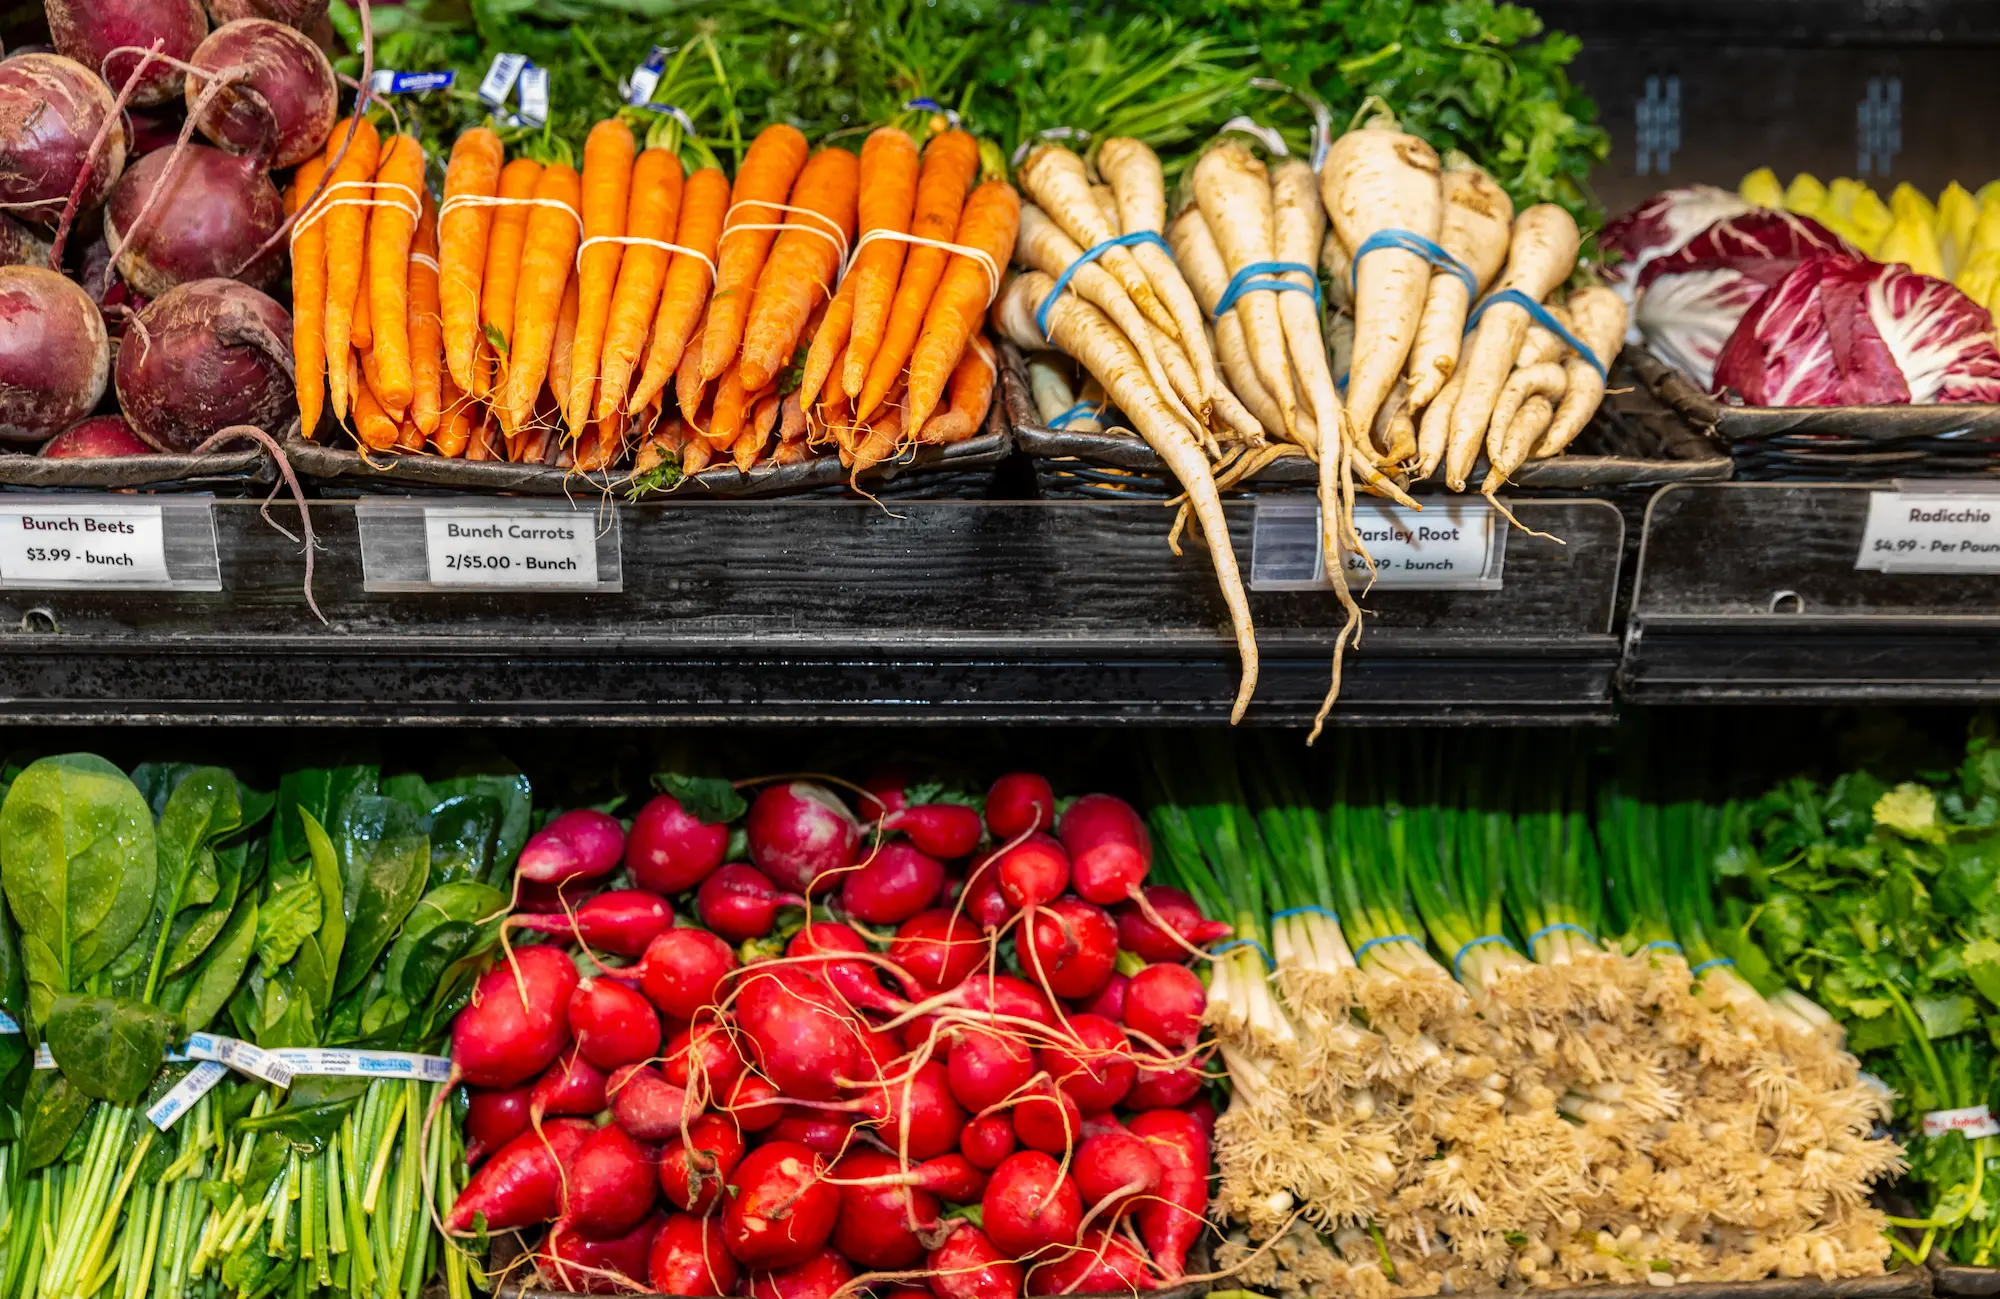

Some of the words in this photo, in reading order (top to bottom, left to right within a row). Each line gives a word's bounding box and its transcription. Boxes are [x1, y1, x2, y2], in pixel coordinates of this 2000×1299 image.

[1909, 508, 1991, 523] Radicchio
[21, 516, 80, 532] Bunch
[84, 518, 135, 534] Beets
[447, 523, 503, 538] Bunch
[507, 525, 575, 540] Carrots
[1418, 527, 1460, 541] Root
[1873, 540, 1918, 552] $4.99
[1930, 540, 1958, 553] Per
[27, 547, 71, 562] $3.99
[86, 550, 134, 566] bunch
[445, 554, 511, 571] 2/$5.00
[526, 557, 577, 571] Bunch
[1404, 559, 1454, 571] bunch
